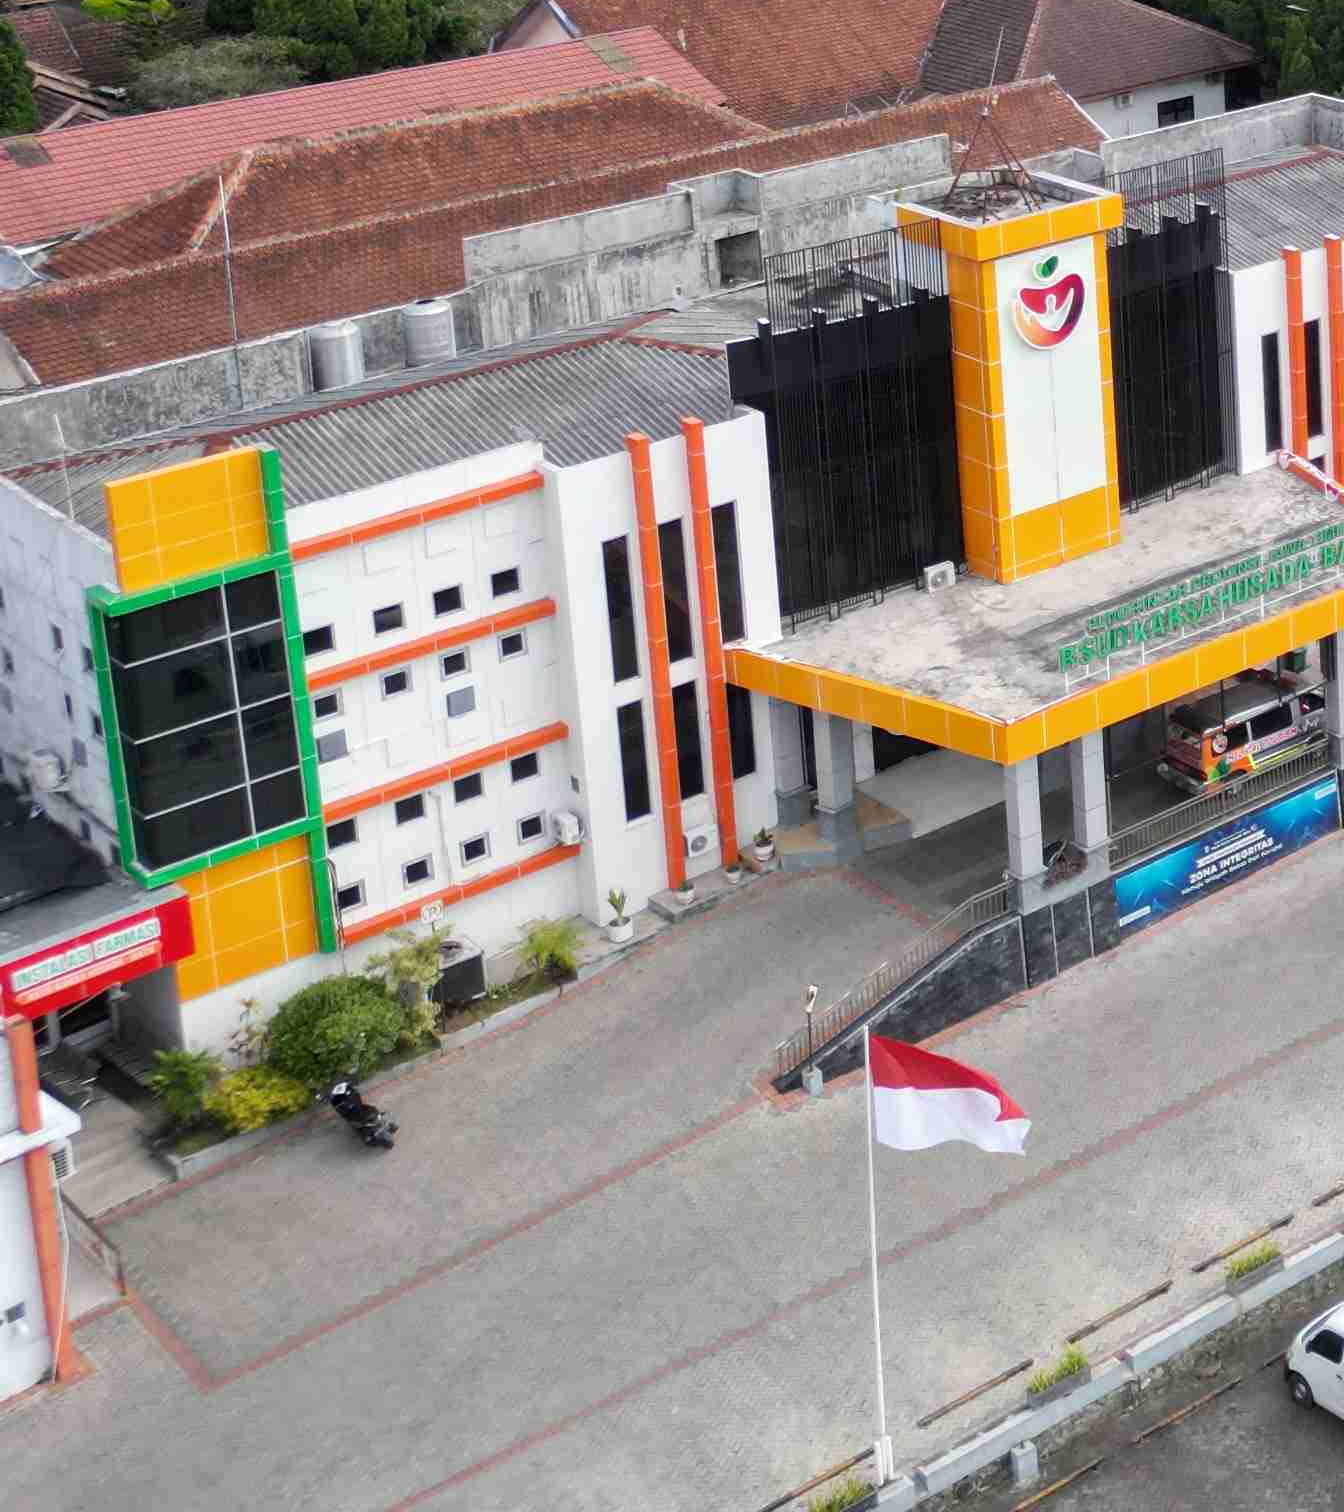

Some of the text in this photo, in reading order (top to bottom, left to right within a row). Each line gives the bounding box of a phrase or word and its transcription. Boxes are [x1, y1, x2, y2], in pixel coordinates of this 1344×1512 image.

[1058, 624, 1129, 673] RSUD
[1132, 595, 1216, 643] KARSA
[1216, 557, 1312, 611] HUSADA
[1189, 864, 1217, 884] ZONA
[1219, 837, 1274, 869] INTEGRITAS
[14, 945, 93, 987] INSTALASI
[95, 919, 160, 956] FARMASI
